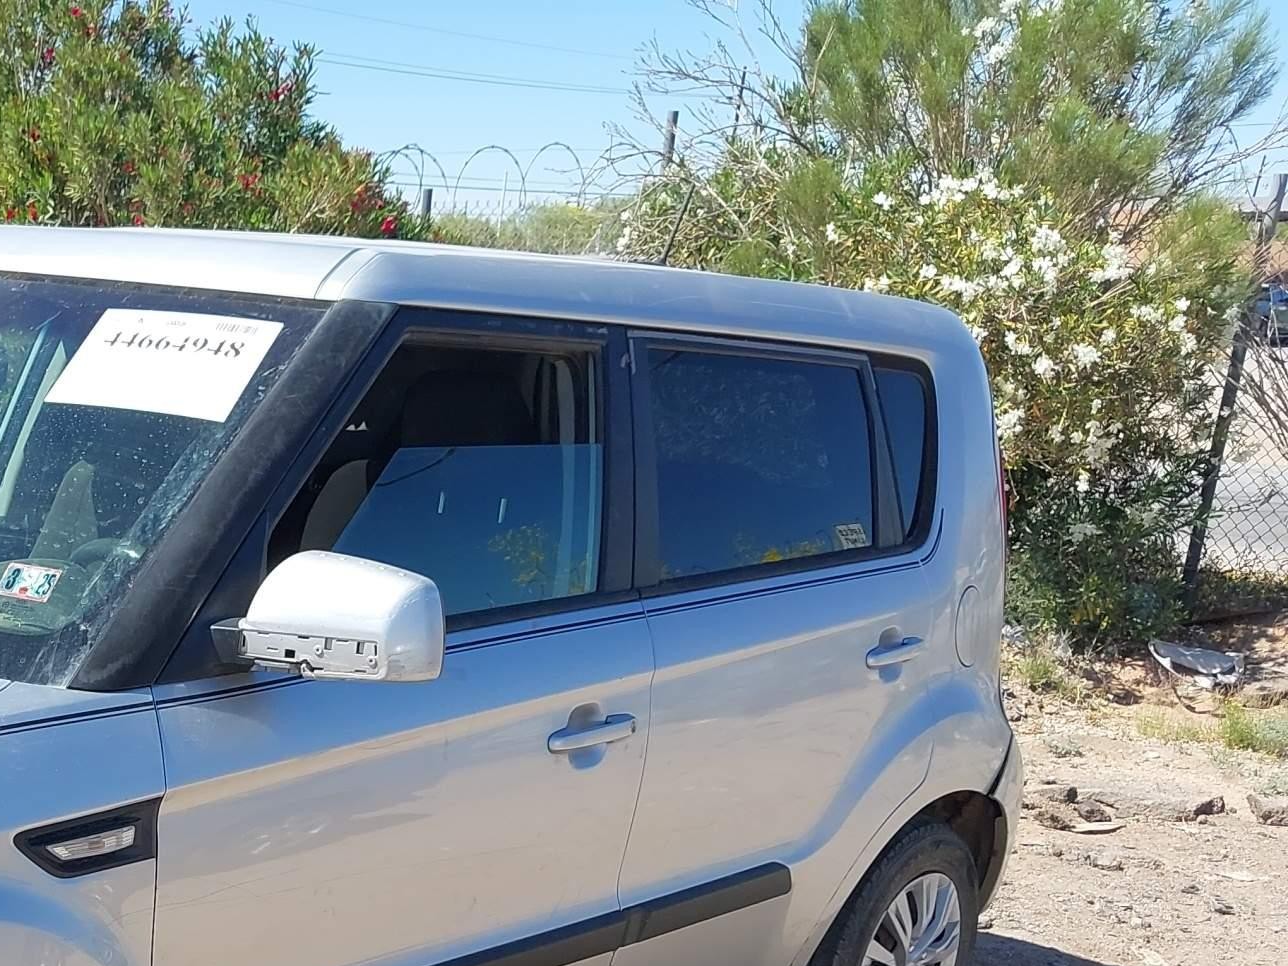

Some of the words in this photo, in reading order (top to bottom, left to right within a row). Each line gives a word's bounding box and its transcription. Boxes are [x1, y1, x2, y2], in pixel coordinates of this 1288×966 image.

[103, 331, 246, 359] 44664948
[4, 567, 22, 590] 3
[34, 573, 58, 596] 25
